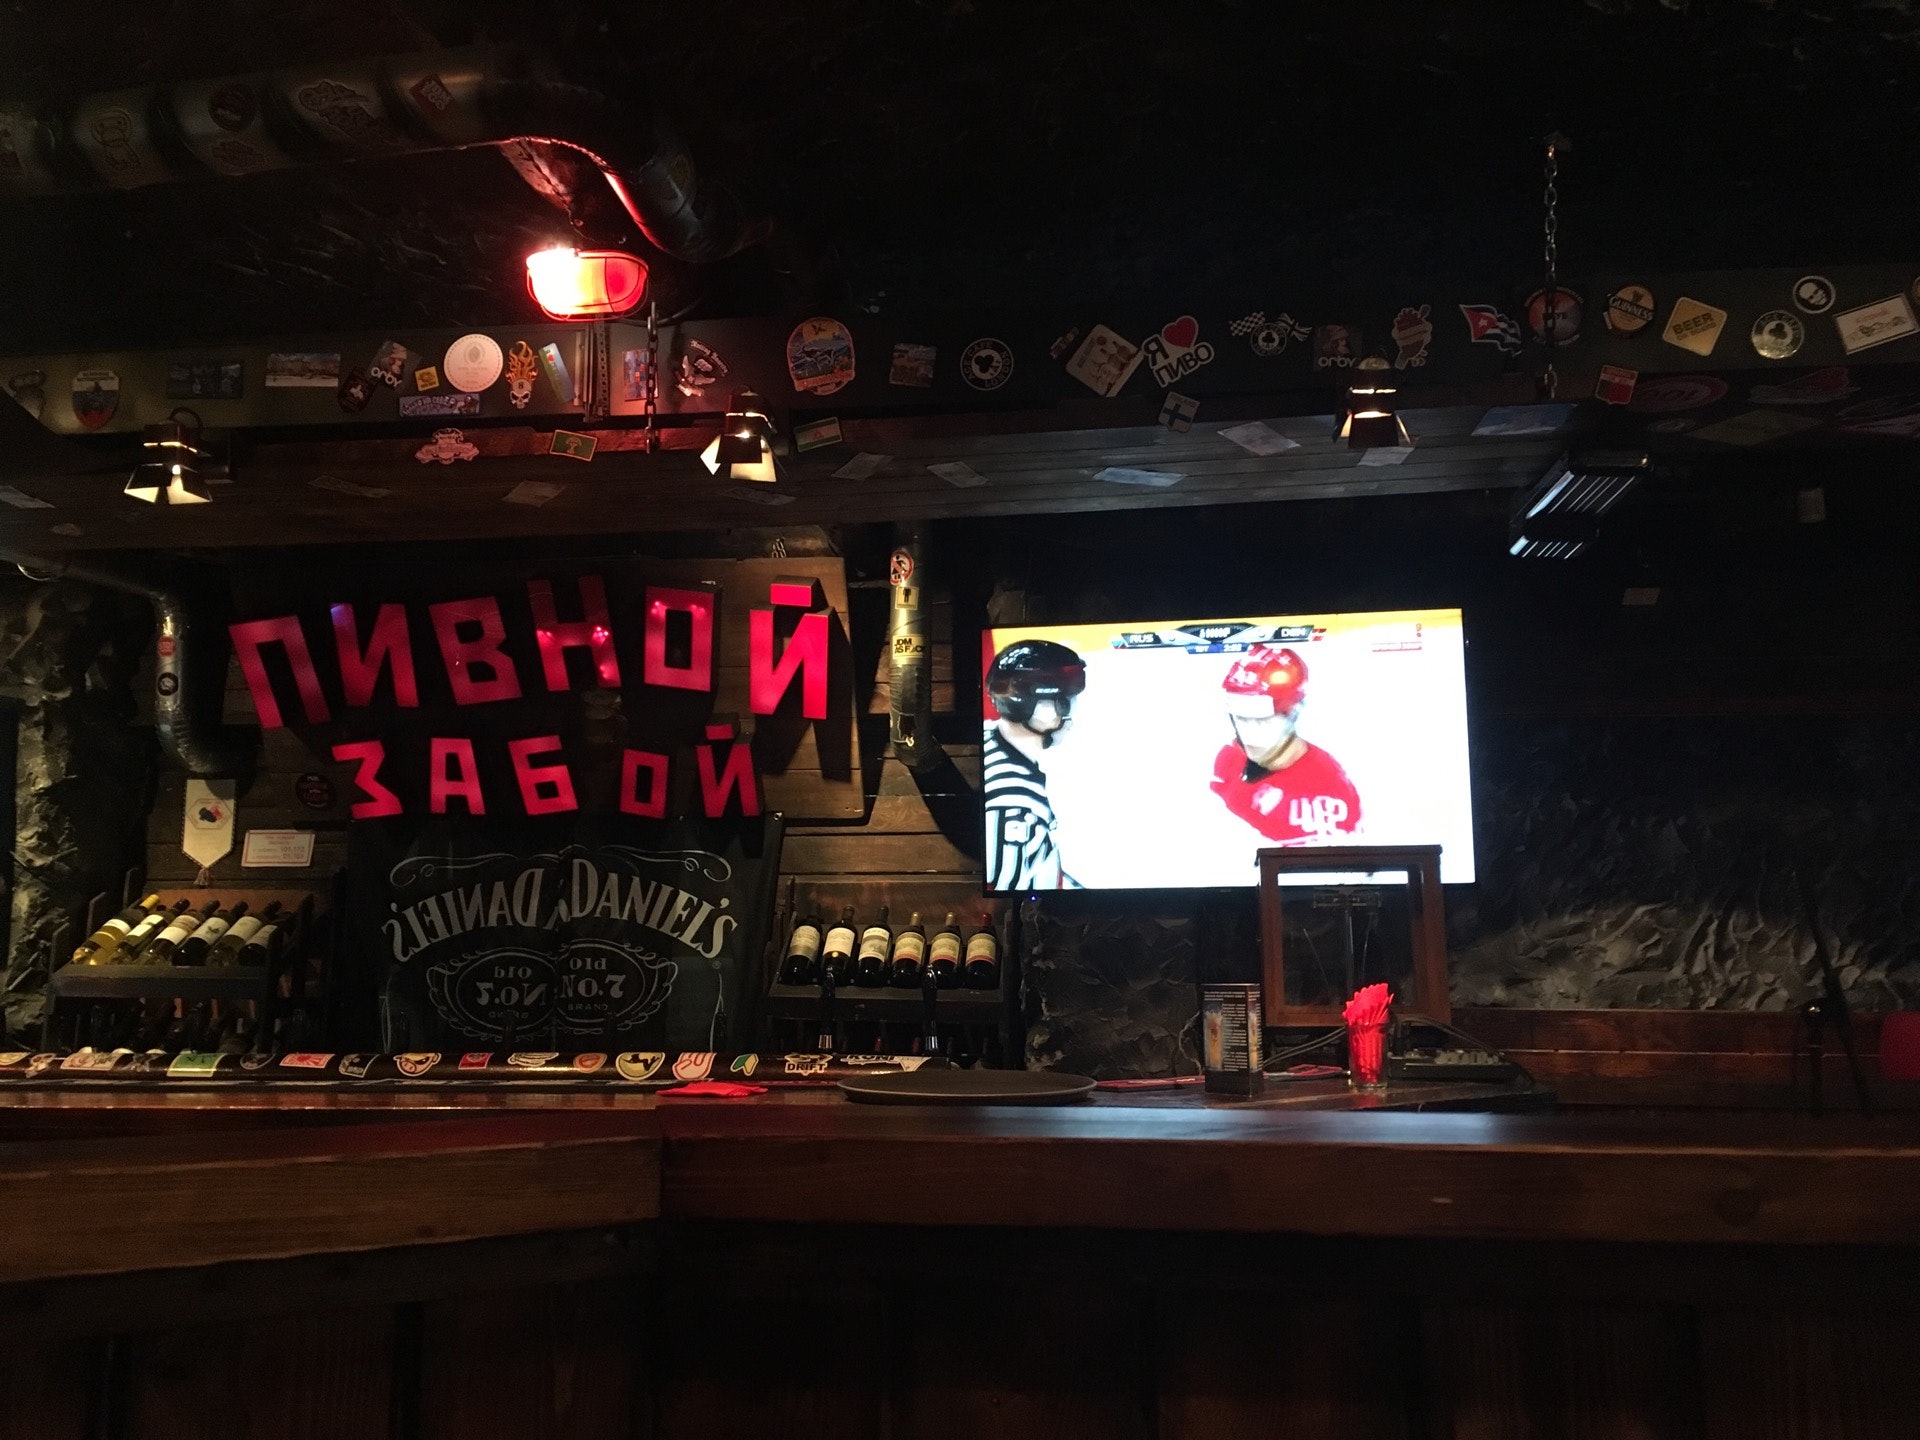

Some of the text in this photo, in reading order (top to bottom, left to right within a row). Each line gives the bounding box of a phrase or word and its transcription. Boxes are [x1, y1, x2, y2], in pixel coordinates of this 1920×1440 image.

[1672, 312, 1714, 335] BEER
[370, 366, 403, 388] orby
[1143, 336, 1213, 386] Я ПИВО
[228, 575, 830, 729] ПИВНОЙ
[331, 724, 760, 820] ЗАБОЙ
[572, 858, 739, 959] DANIEL'S
[787, 1063, 826, 1072] DRIFT
